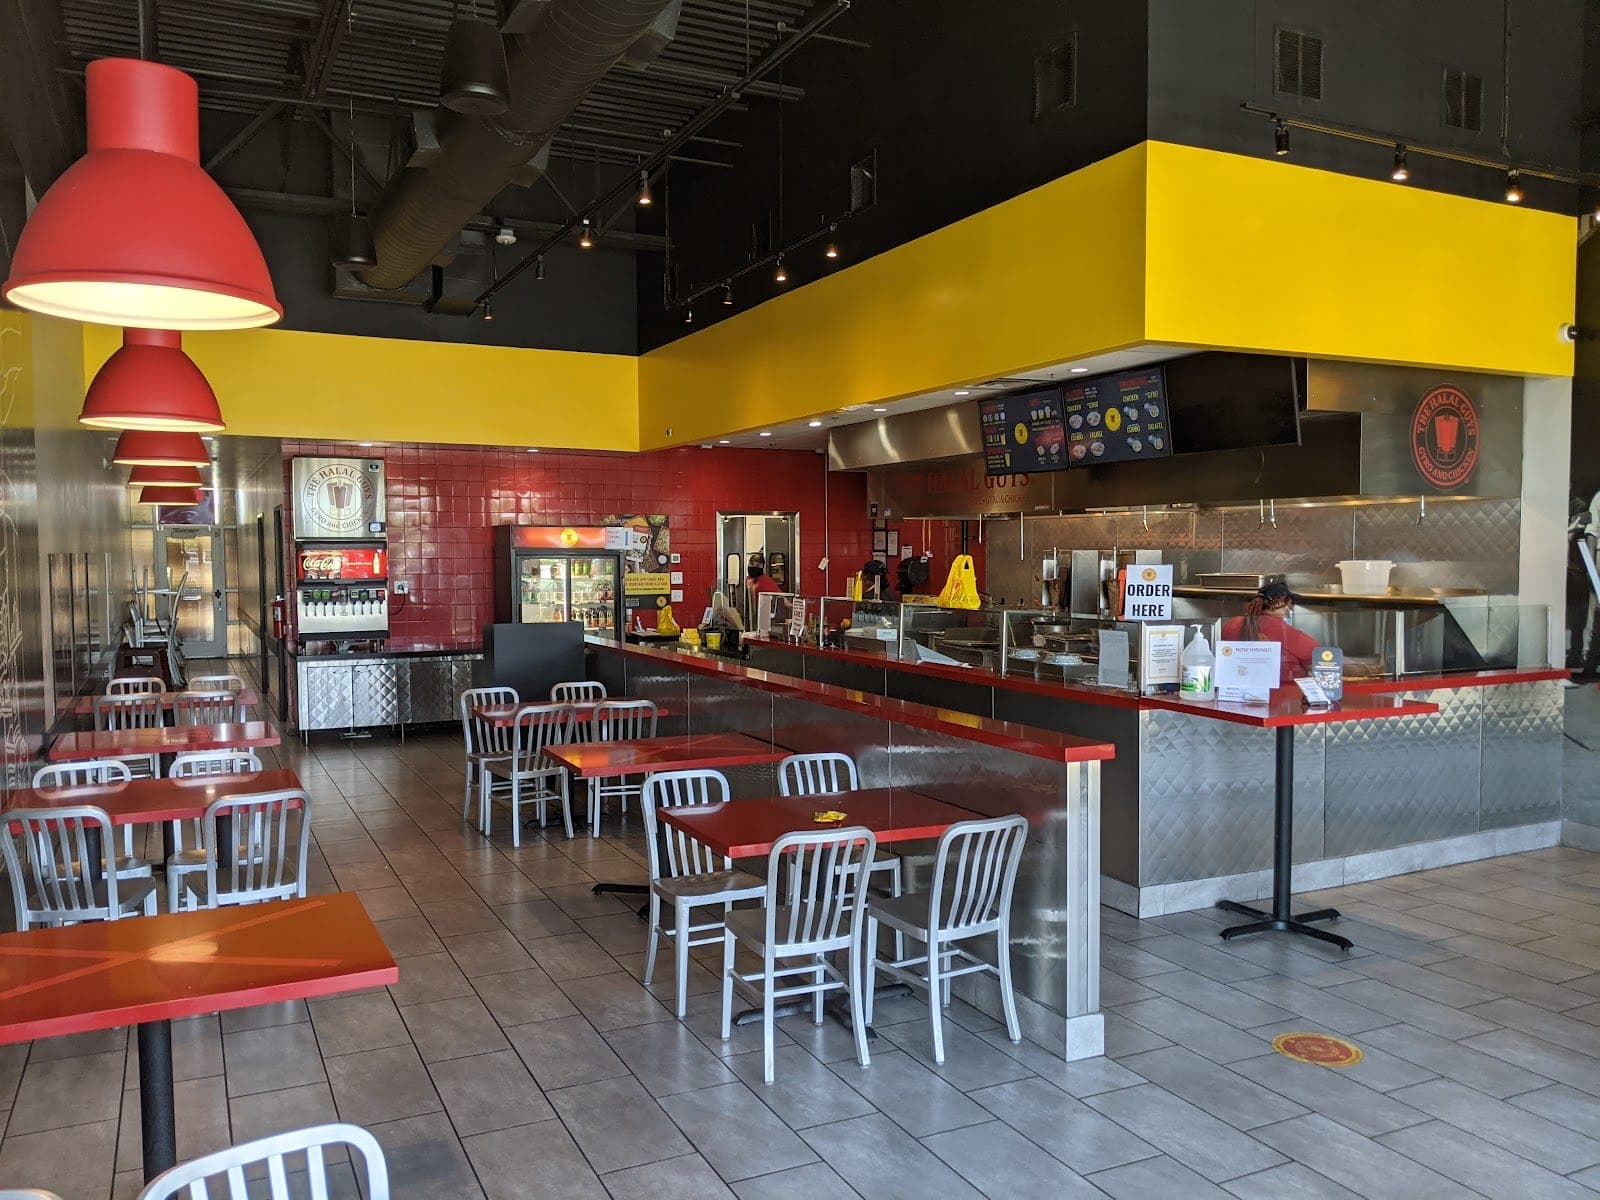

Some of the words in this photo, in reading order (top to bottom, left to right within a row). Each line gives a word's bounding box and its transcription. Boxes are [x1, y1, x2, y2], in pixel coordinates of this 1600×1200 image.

[1417, 406, 1431, 433] THE
[1432, 394, 1460, 409] HALAL
[1460, 402, 1475, 435] GUYS
[1418, 446, 1433, 472] GYRO
[1431, 468, 1447, 480] AND
[1448, 448, 1475, 479] CHICKEN
[307, 478, 320, 497] THE
[320, 467, 354, 480] HALAL
[356, 476, 373, 499] GUYS
[342, 511, 369, 529] CHICN
[303, 556, 341, 571] Coca-Co
[1127, 584, 1170, 597] ORDER
[1132, 604, 1164, 616] HERE
